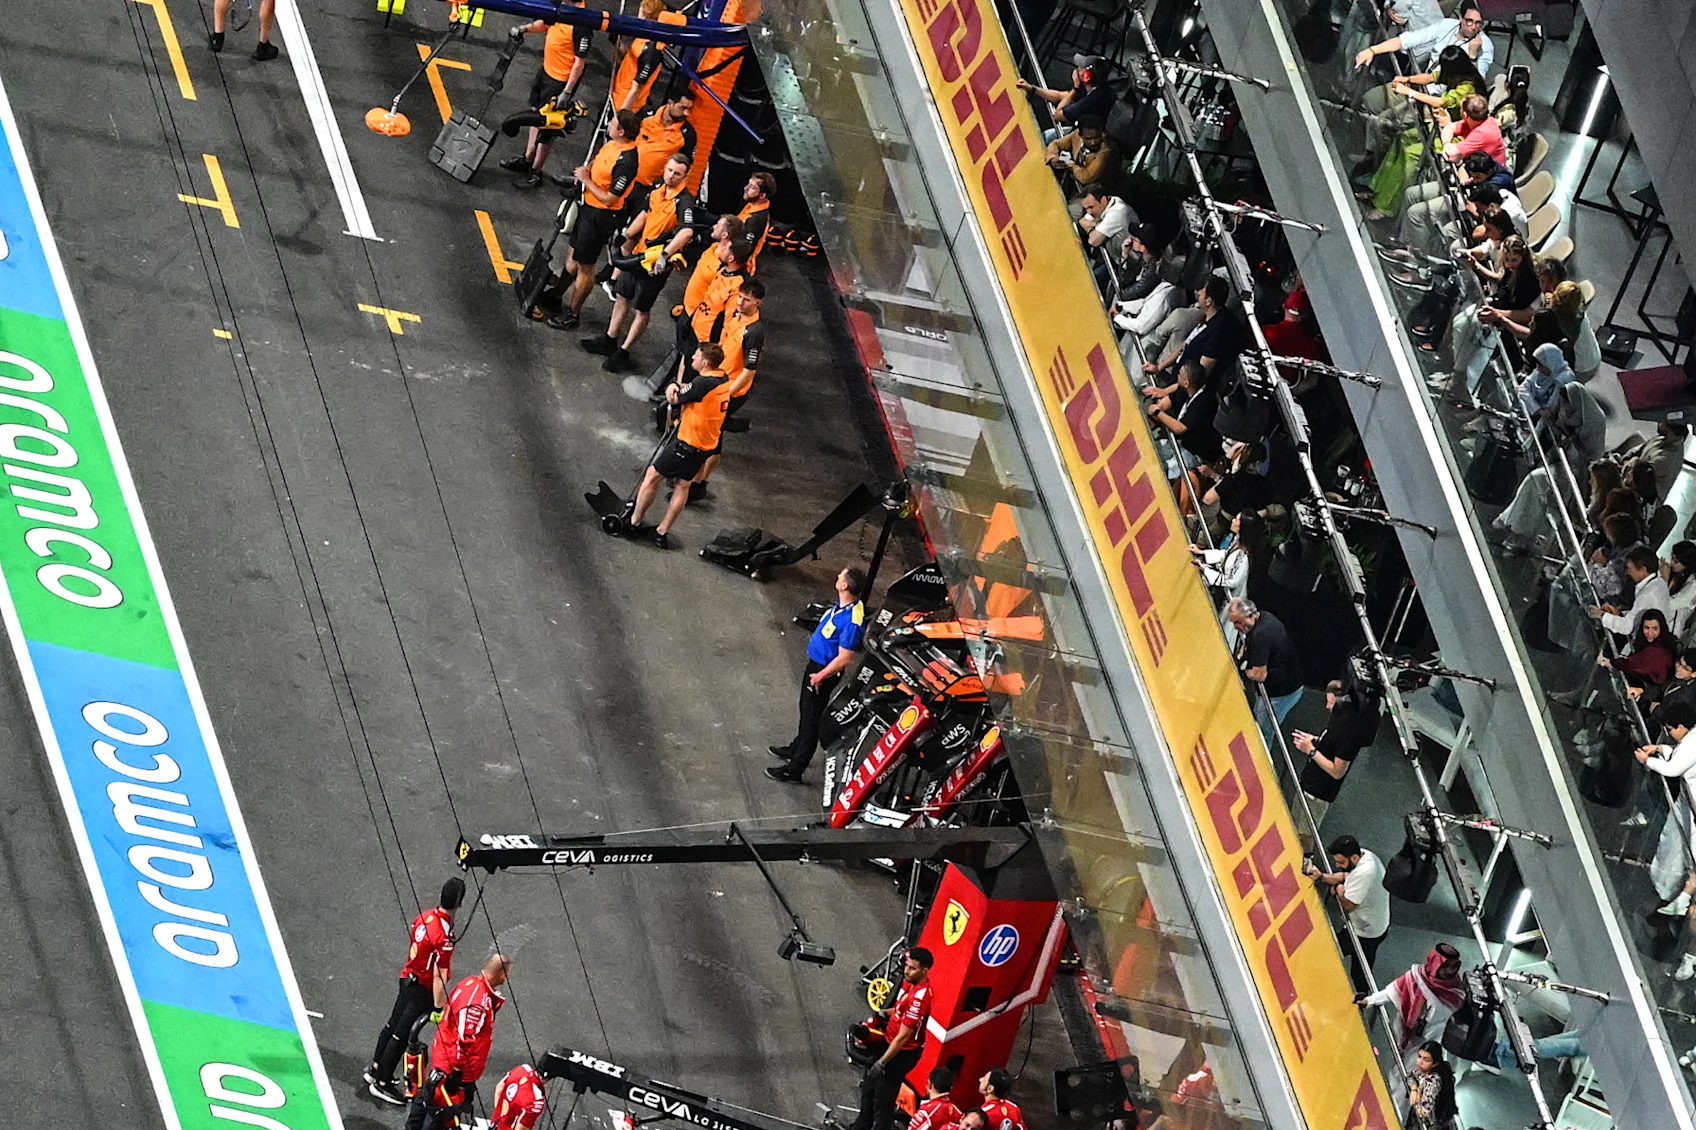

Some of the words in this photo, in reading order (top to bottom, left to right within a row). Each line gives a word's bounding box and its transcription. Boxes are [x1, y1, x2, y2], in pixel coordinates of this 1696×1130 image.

[926, 0, 1029, 235] DHL
[904, 325, 949, 342] ORLD
[1064, 343, 1170, 619] DHL
[833, 697, 861, 723] aws
[939, 722, 967, 747] aws
[82, 701, 240, 968] aramco
[603, 854, 653, 863] OGISTICS
[1205, 731, 1313, 1014] DHL
[981, 925, 1017, 967] hp
[568, 1050, 626, 1079] IBM
